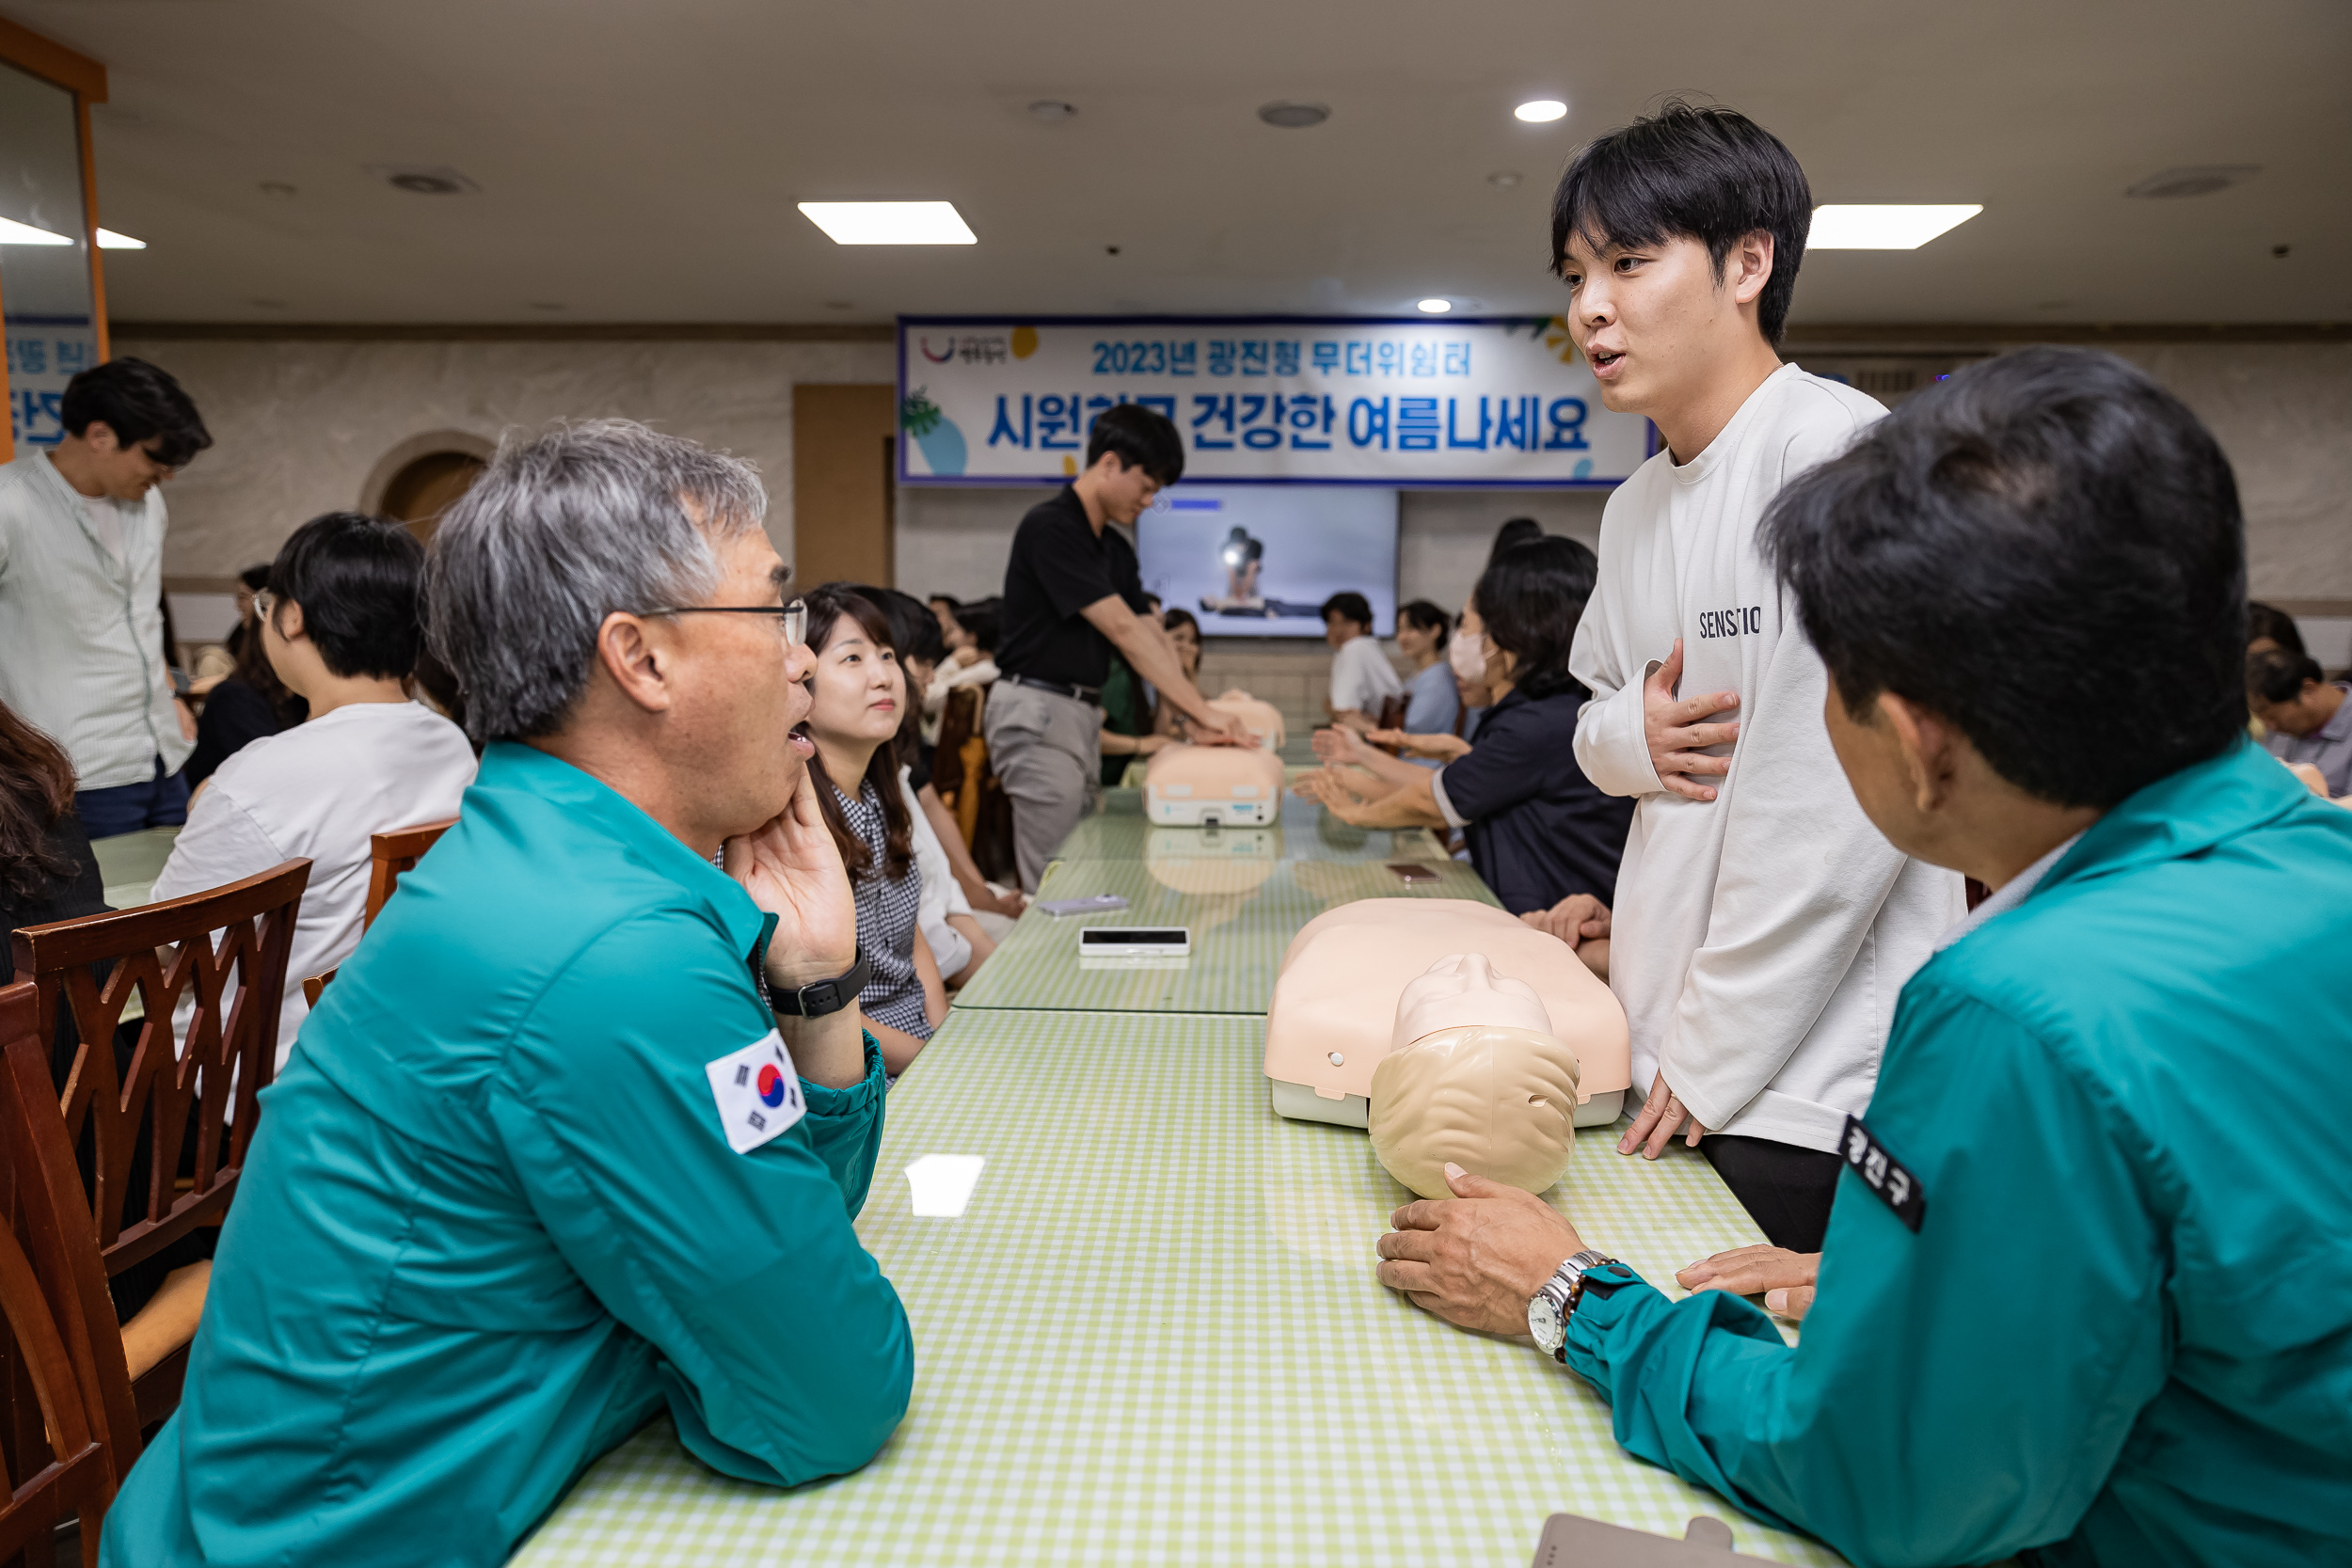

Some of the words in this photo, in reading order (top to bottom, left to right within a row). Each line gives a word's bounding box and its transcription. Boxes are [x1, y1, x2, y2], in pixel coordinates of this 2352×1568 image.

[1093, 341, 1196, 376] 2023년
[1312, 341, 1470, 376] 무더위쉼터
[1192, 393, 1337, 451] 건강한
[1348, 395, 1591, 451] 여름나세요
